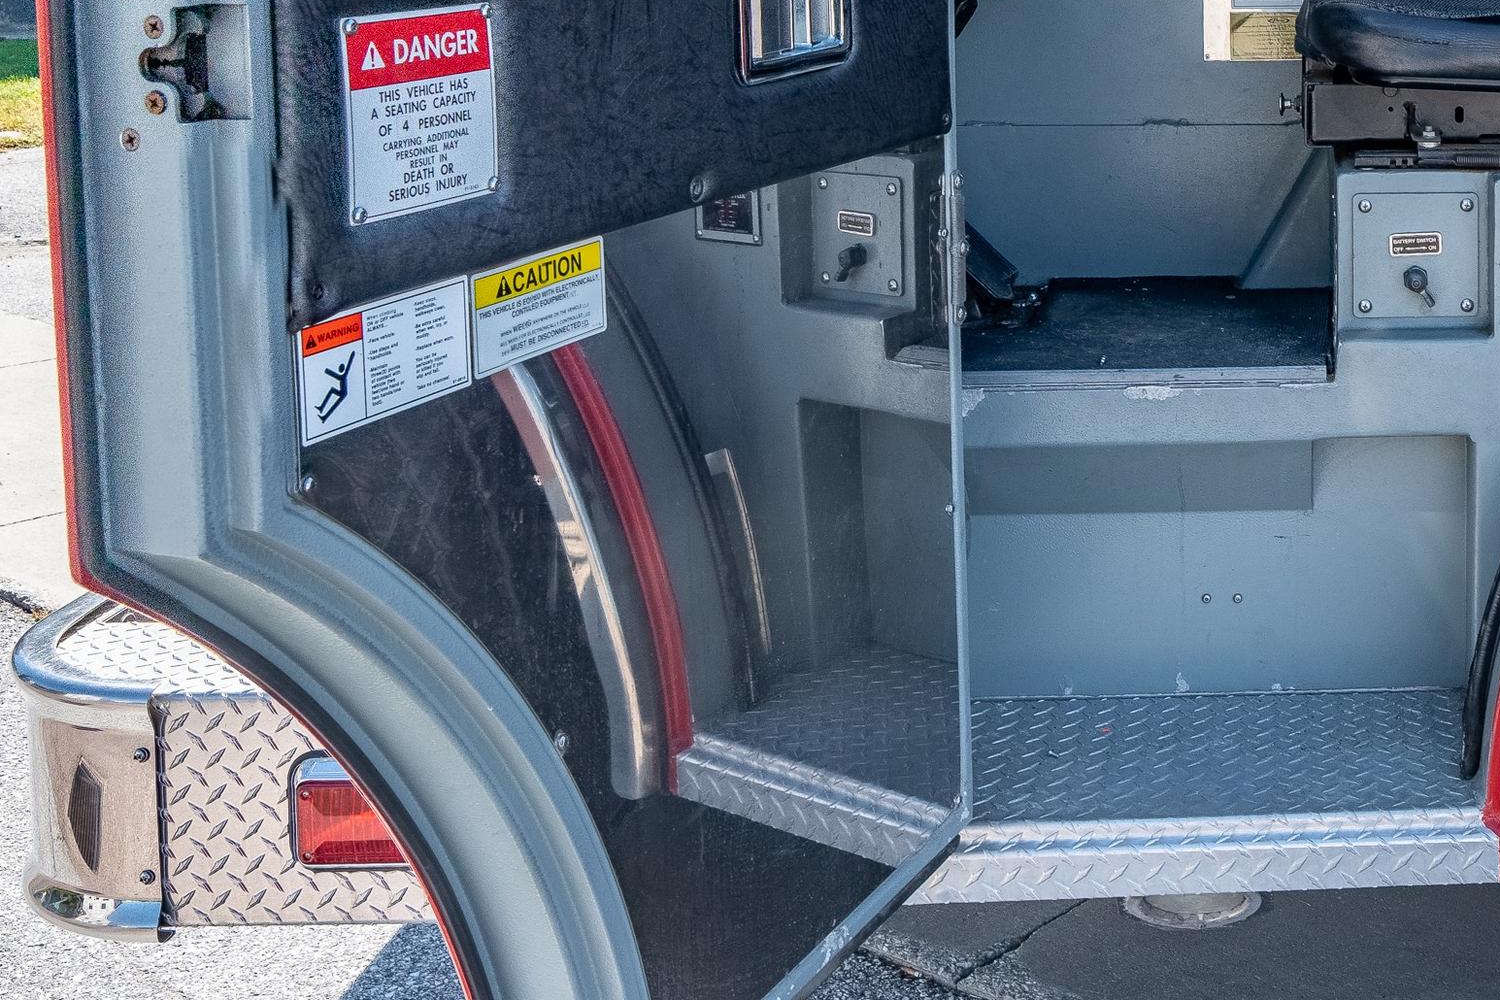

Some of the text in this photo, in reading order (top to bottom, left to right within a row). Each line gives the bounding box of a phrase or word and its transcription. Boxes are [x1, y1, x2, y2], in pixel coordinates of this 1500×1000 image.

[394, 28, 479, 65] DANGER
[379, 78, 468, 104] THIS VEHICLE HAS
[371, 91, 476, 120] A SEATING CAPACITY
[378, 110, 472, 137] OF 4 PERSONNEL
[383, 128, 469, 152] CARRYING ADDITIONAL
[396, 139, 459, 161] PERSONNEL MAY
[403, 163, 454, 184] DEATH OR
[410, 154, 448, 169] RESULT IN
[389, 183, 430, 202] SERIOUS
[436, 174, 468, 192] INJURY
[513, 252, 582, 292] CAUTION
[479, 311, 492, 320] THIS
[493, 303, 516, 316] VEHICLE
[556, 274, 599, 294] ELECTRONICALLY
[316, 322, 359, 343] WARNING
[510, 341, 527, 351] MUST
[528, 337, 536, 346] BE
[538, 321, 581, 342] DISCONNECTED
